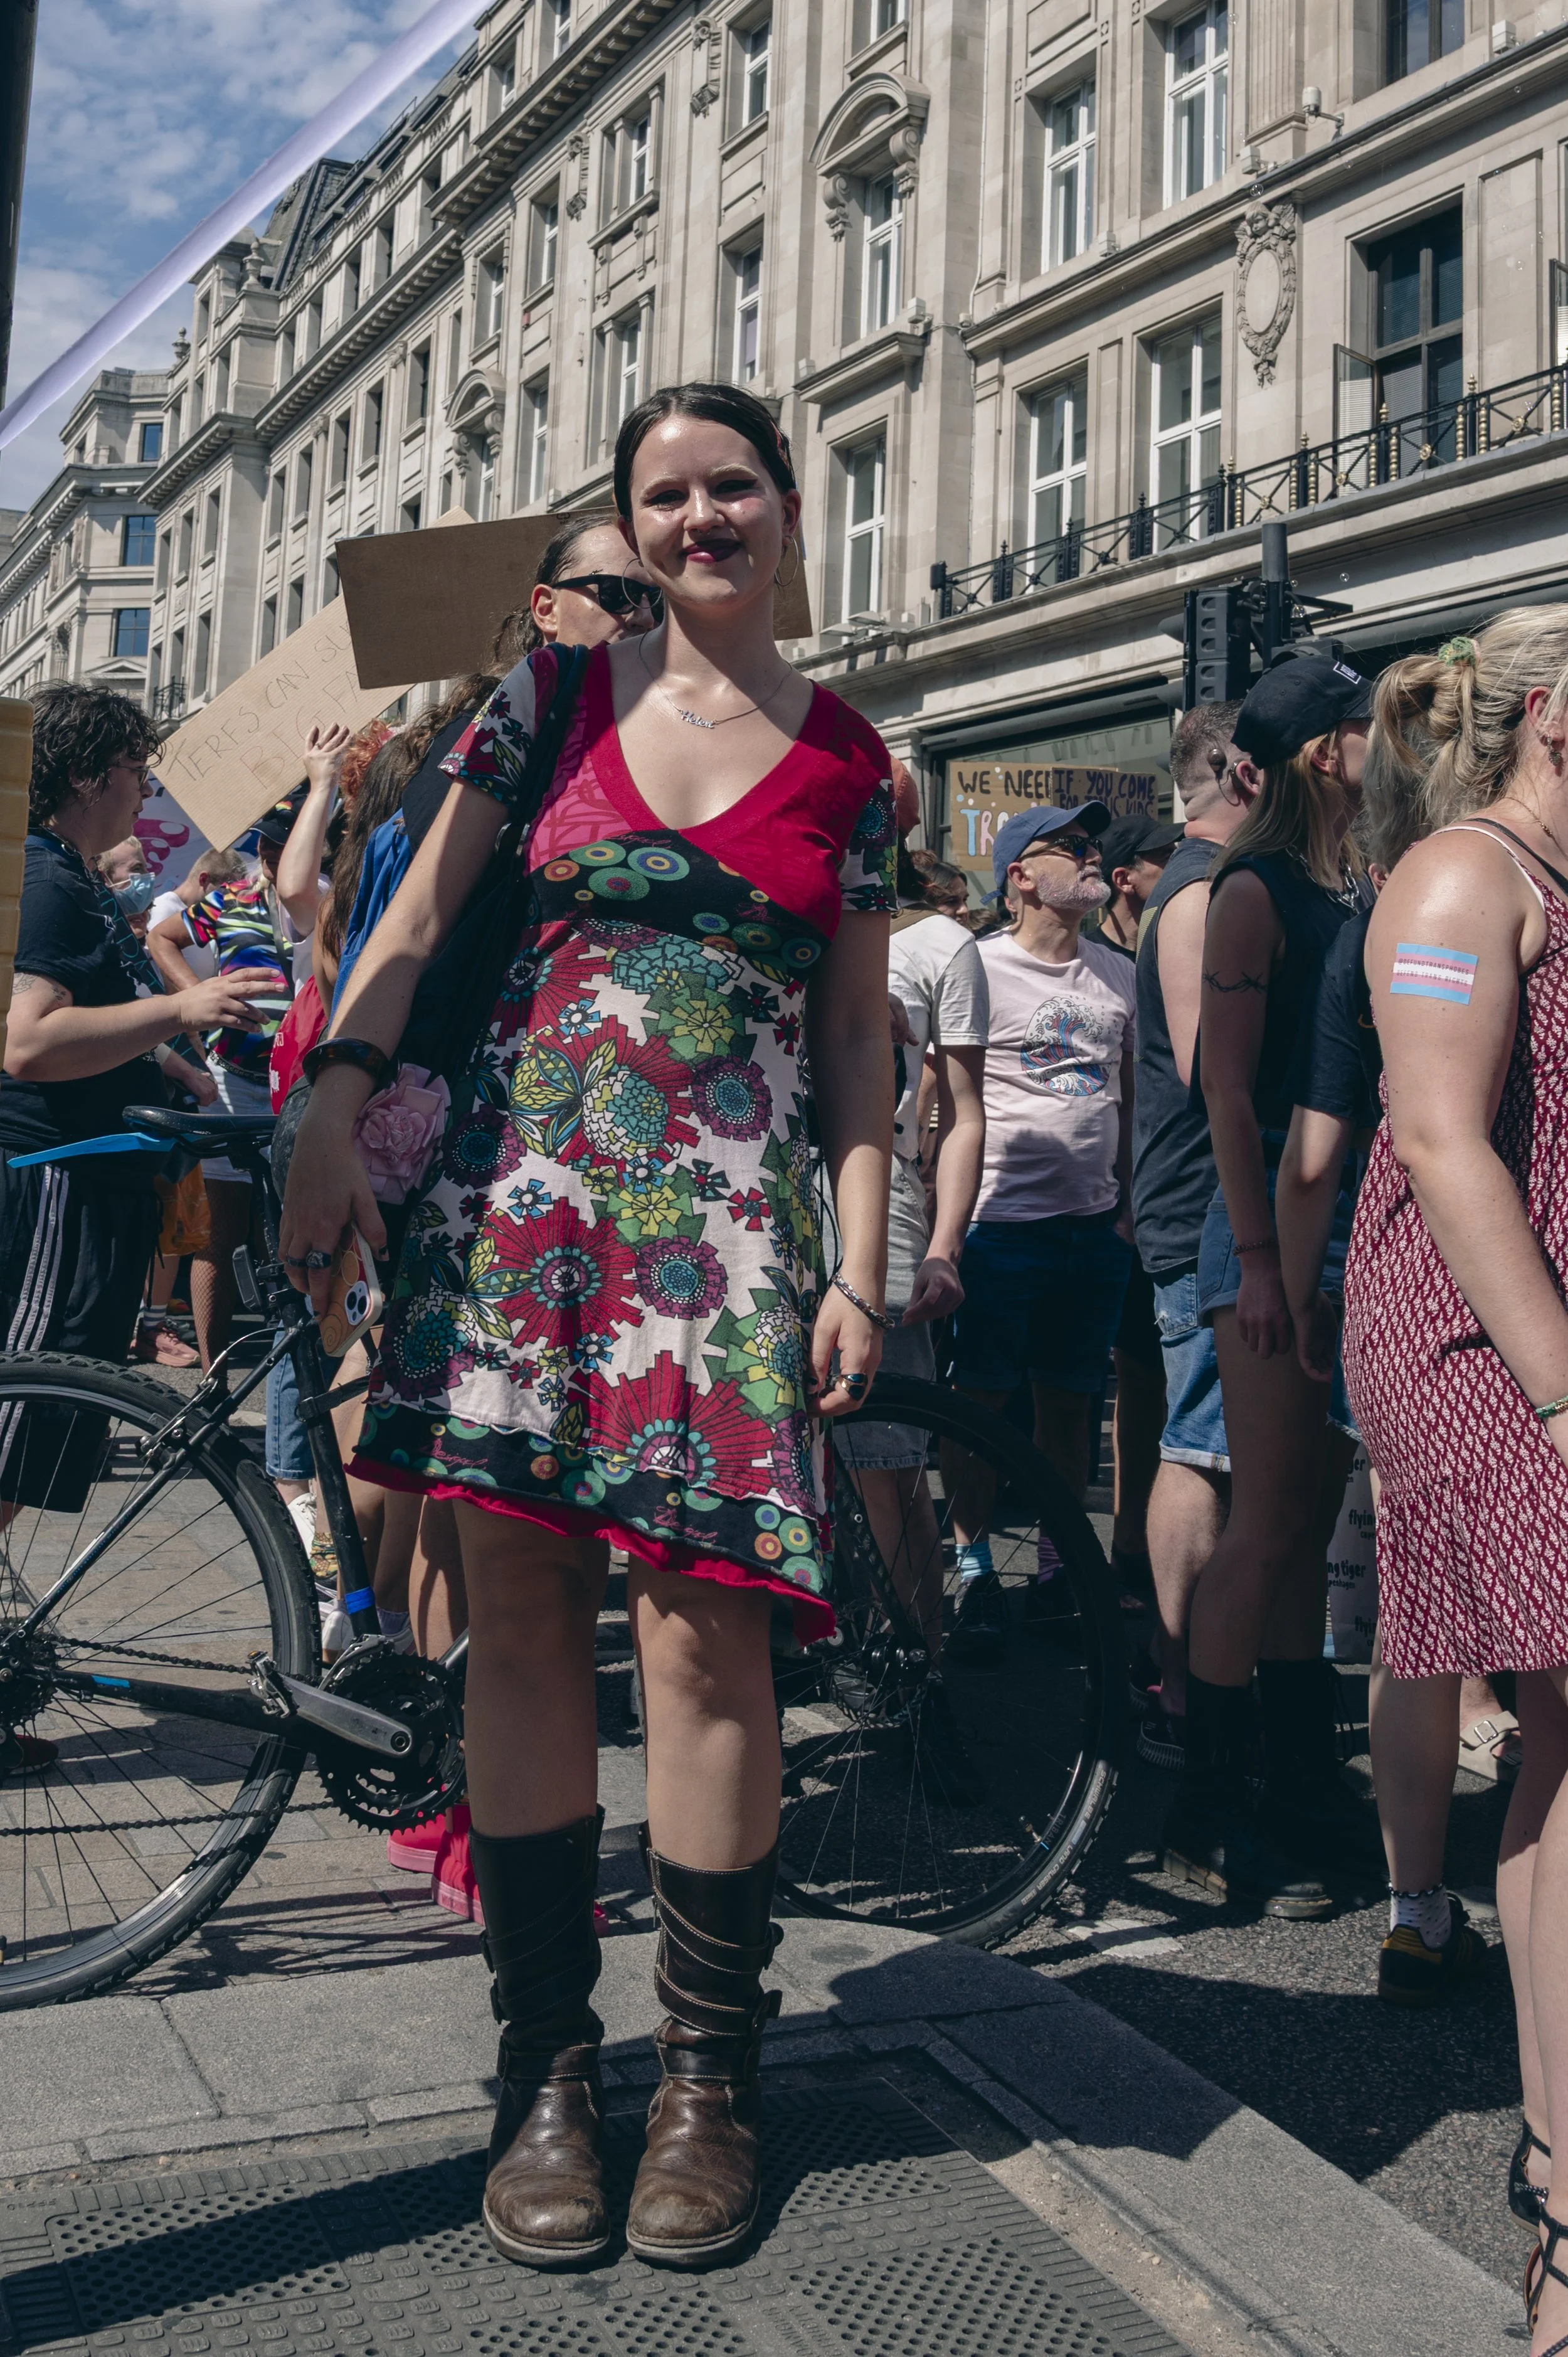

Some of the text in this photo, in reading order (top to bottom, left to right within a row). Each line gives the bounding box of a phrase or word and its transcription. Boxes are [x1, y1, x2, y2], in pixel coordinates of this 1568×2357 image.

[166, 706, 259, 781] TERFS
[265, 660, 310, 710] CAN
[681, 710, 715, 729] Helen
[957, 770, 991, 794] WE
[1054, 770, 1157, 801] IF YOU COME
[1396, 969, 1468, 987] DEFEND TRANS RIGHTS
[1340, 1558, 1366, 1580] tiger
[1084, 1769, 1107, 1819] SCHWALBE
[1059, 1844, 1073, 1865] LAND
